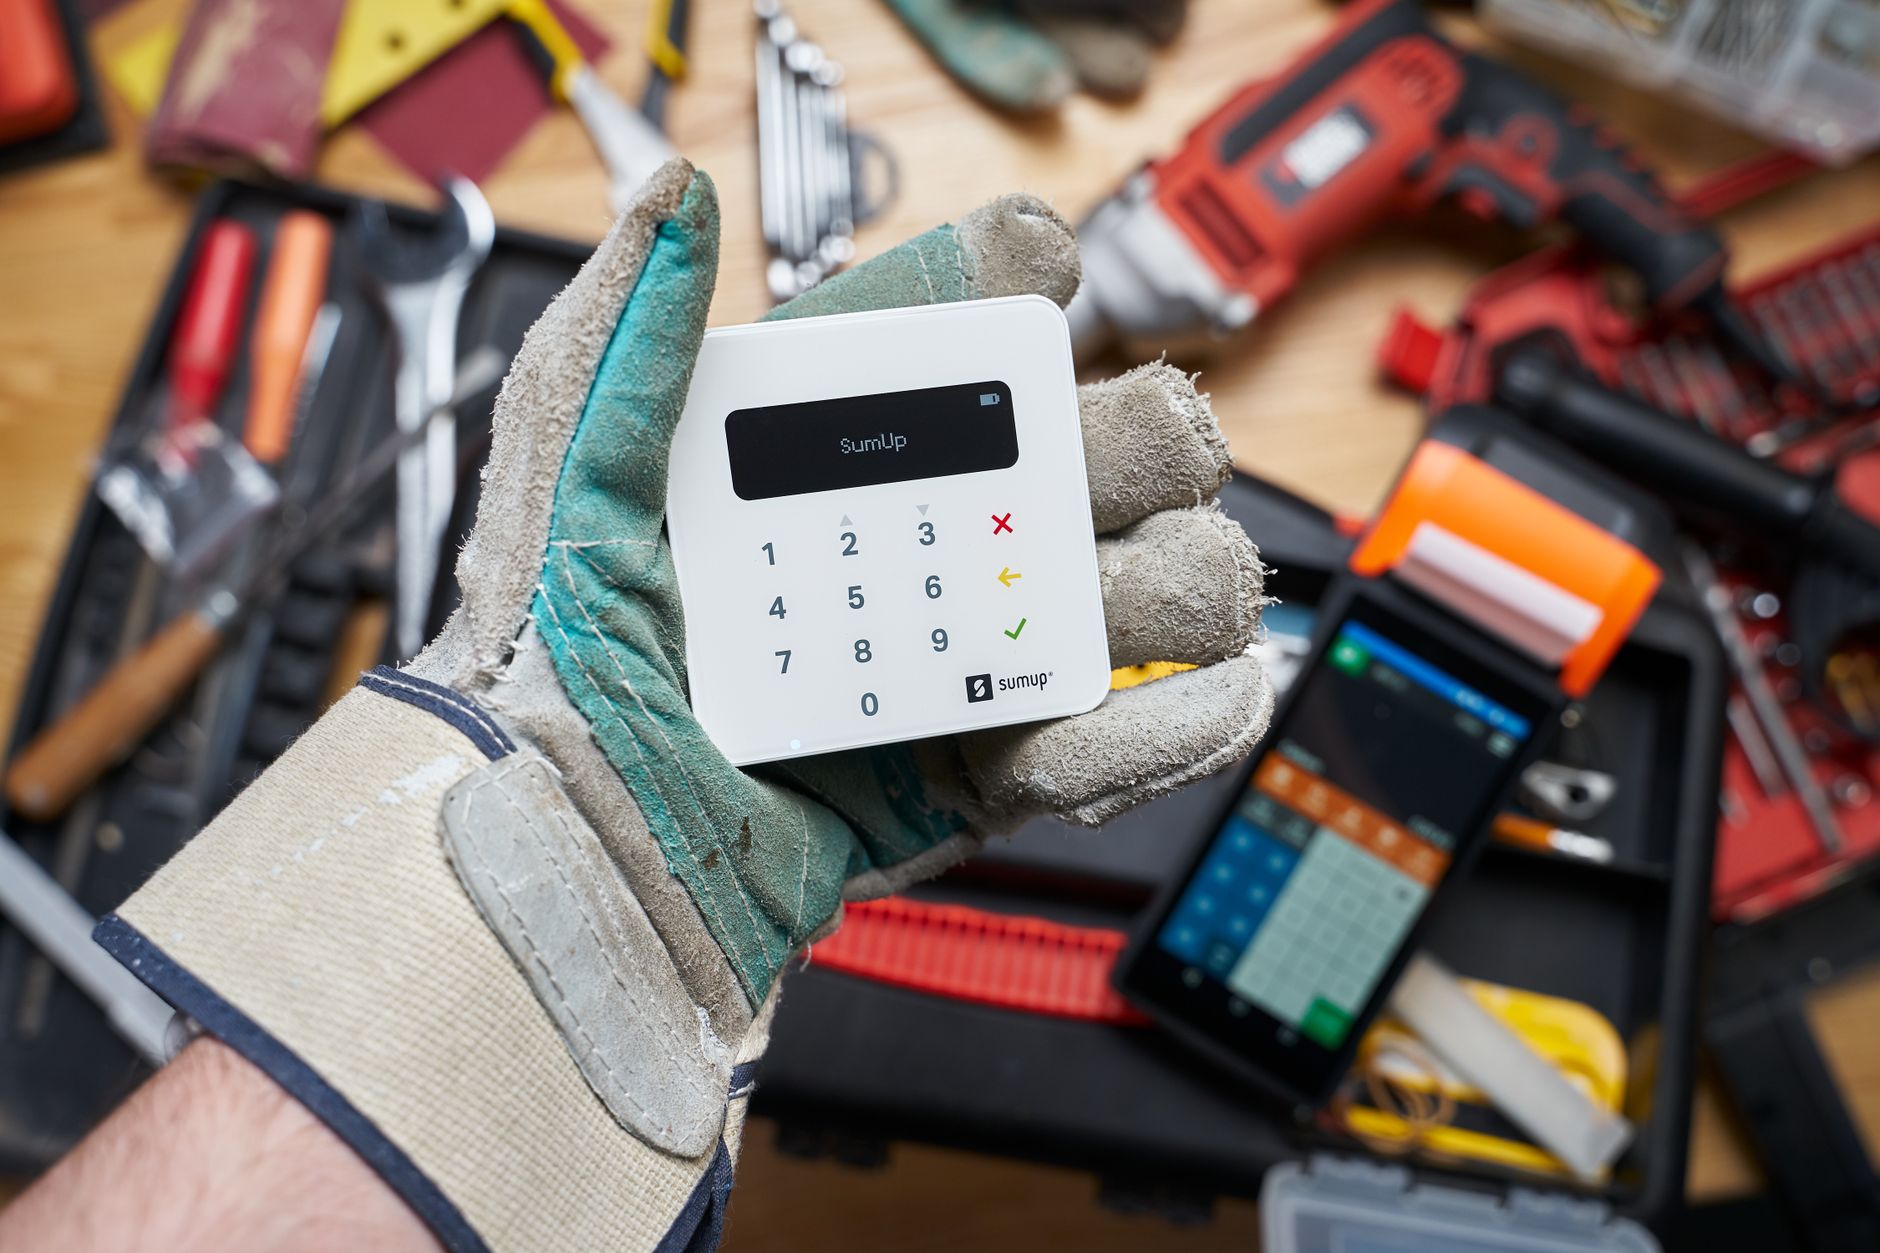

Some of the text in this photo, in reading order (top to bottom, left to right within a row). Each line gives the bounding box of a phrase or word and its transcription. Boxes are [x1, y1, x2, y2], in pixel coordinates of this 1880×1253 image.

[840, 433, 907, 454] SumUp
[761, 521, 935, 566] 1 2 3
[768, 574, 943, 620] 4 5 6
[774, 628, 949, 675] 7 8 9
[860, 692, 879, 717] 0
